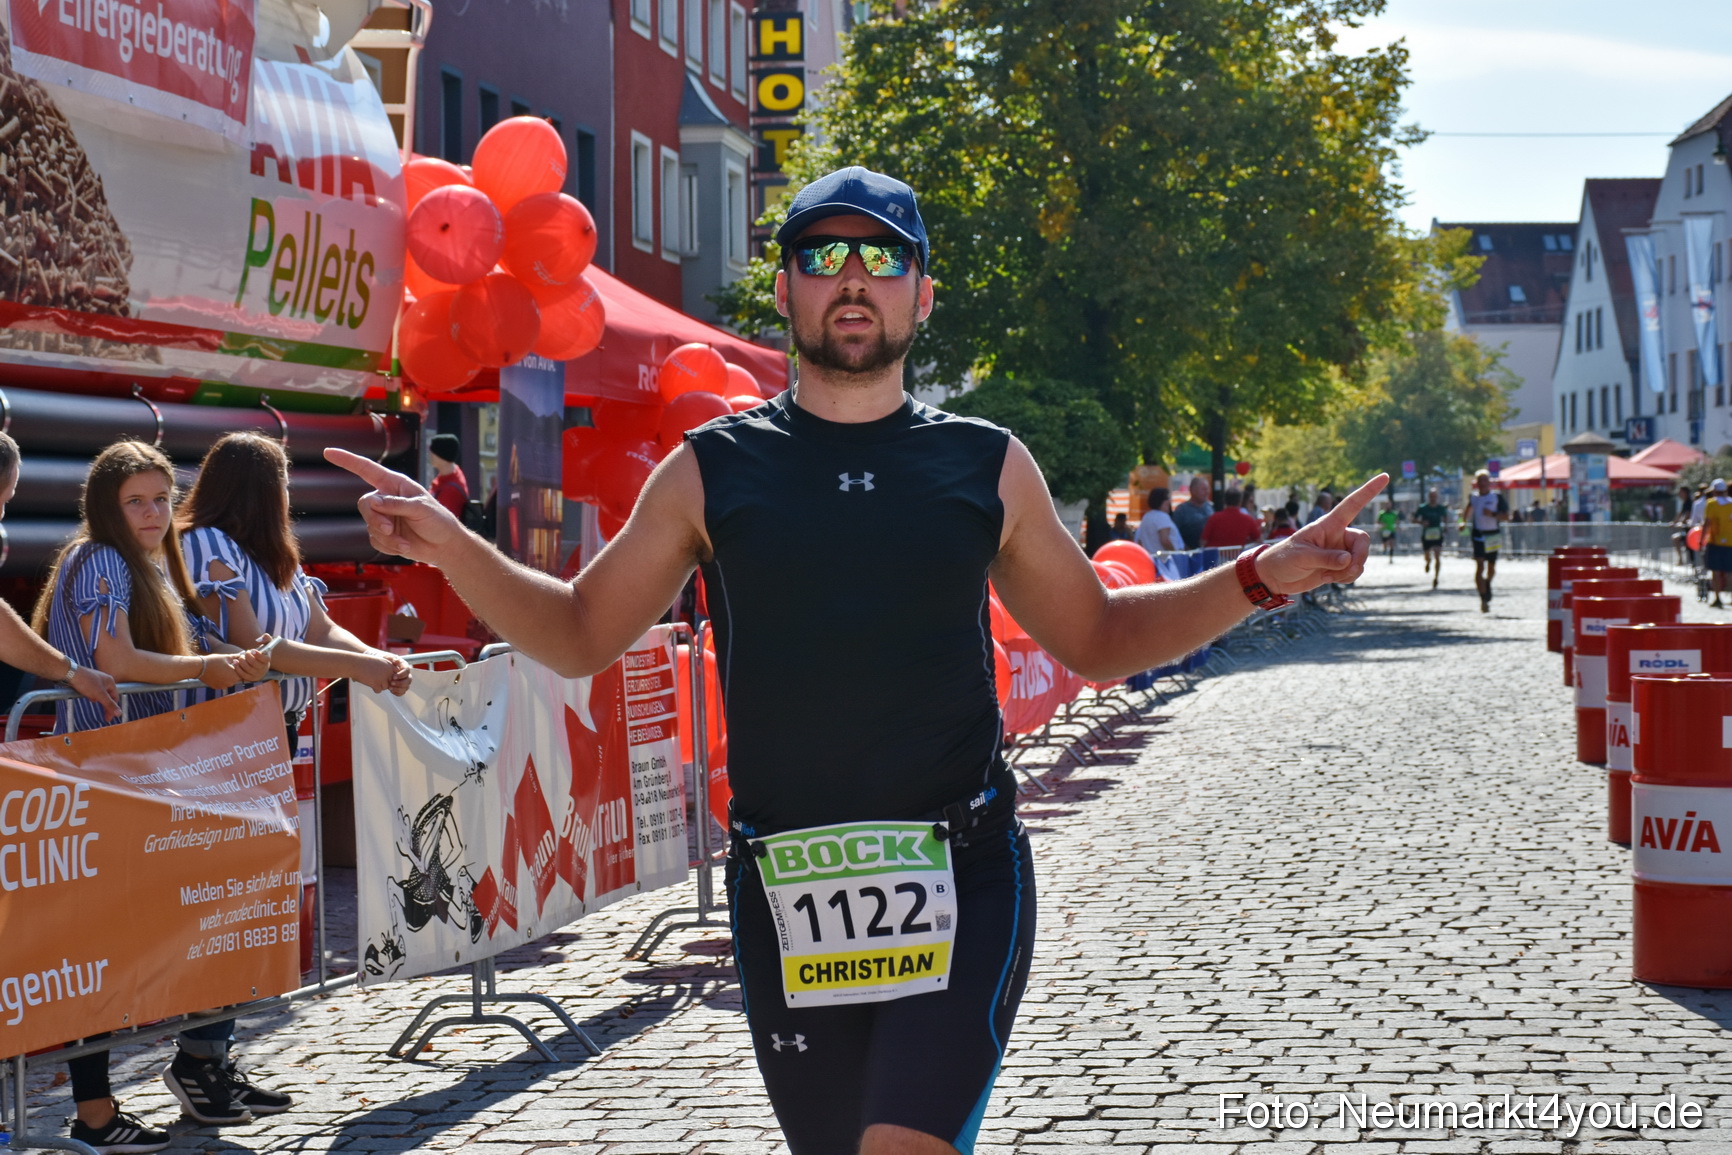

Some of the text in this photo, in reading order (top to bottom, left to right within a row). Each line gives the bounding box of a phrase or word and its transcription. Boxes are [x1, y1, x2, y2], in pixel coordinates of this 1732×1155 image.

[758, 18, 804, 260] HOT
[235, 197, 375, 330] Pellets
[179, 752, 234, 777] moderner
[233, 736, 280, 762] Partner
[631, 761, 650, 774] Braun
[219, 774, 242, 795] und
[970, 786, 997, 810] sailfish
[0, 783, 90, 836] CODE
[170, 803, 197, 823] Ihrer
[636, 816, 649, 829] Tel.
[144, 827, 222, 854] Grafikdesign
[223, 820, 245, 842] und
[638, 832, 651, 845] Fax
[1640, 811, 1722, 853] AVIA
[0, 832, 99, 891] CLINIC
[770, 830, 928, 875] BOCK
[180, 869, 301, 906] Melden Sie sich bei un
[200, 894, 296, 931] web: codeclinic.de
[793, 881, 932, 943] 1122
[187, 939, 205, 960] tel:
[206, 931, 240, 956] 09181
[243, 925, 277, 949] 8833
[799, 952, 935, 985] CHRISTIAN
[0, 959, 109, 1026] gentur
